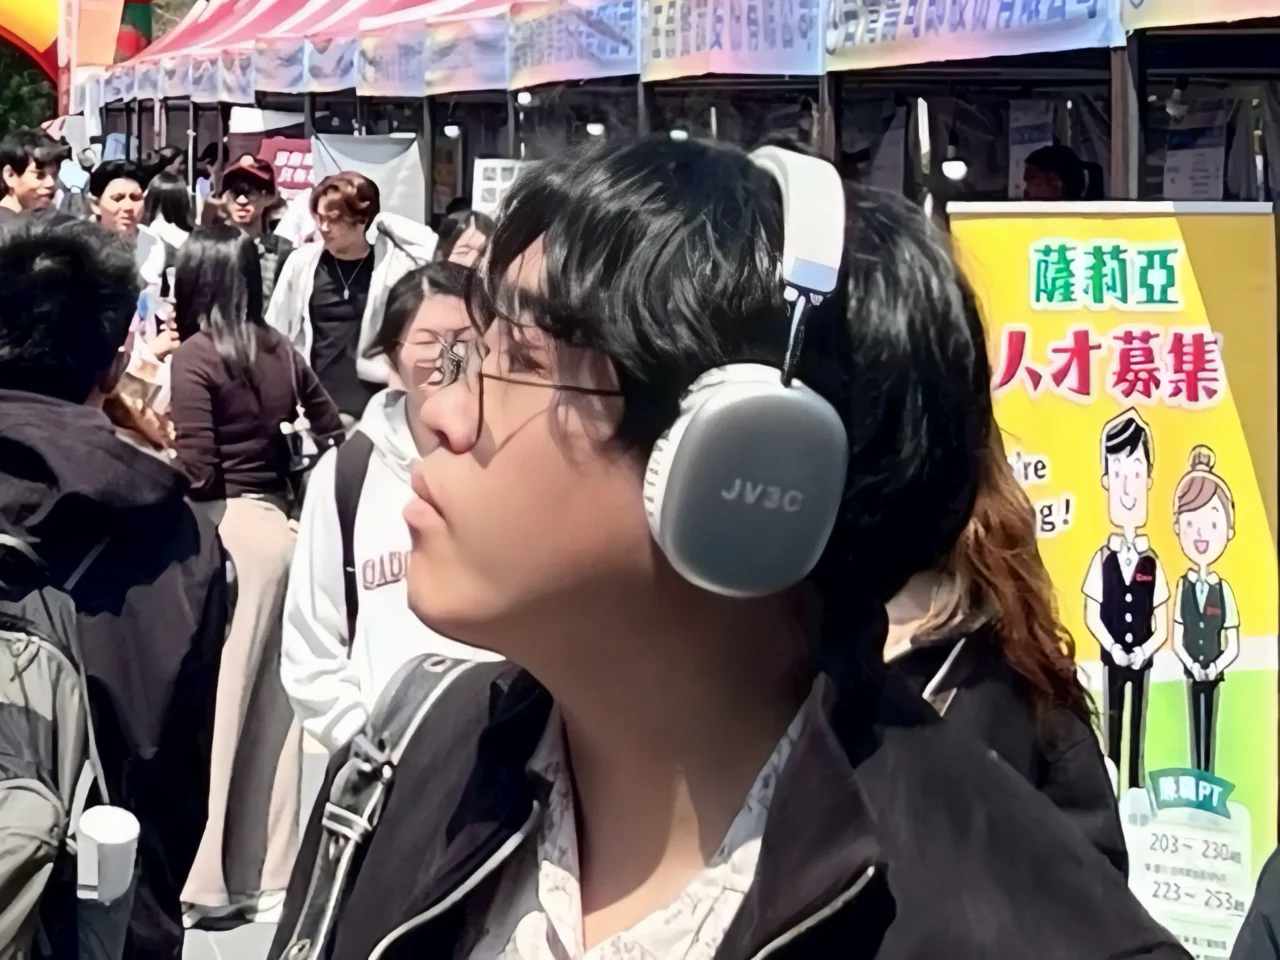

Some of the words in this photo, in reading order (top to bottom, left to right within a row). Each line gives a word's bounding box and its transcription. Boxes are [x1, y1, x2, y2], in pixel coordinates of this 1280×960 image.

[1033, 243, 1179, 305] 薩莉亞
[992, 329, 1220, 403] 人才募集
